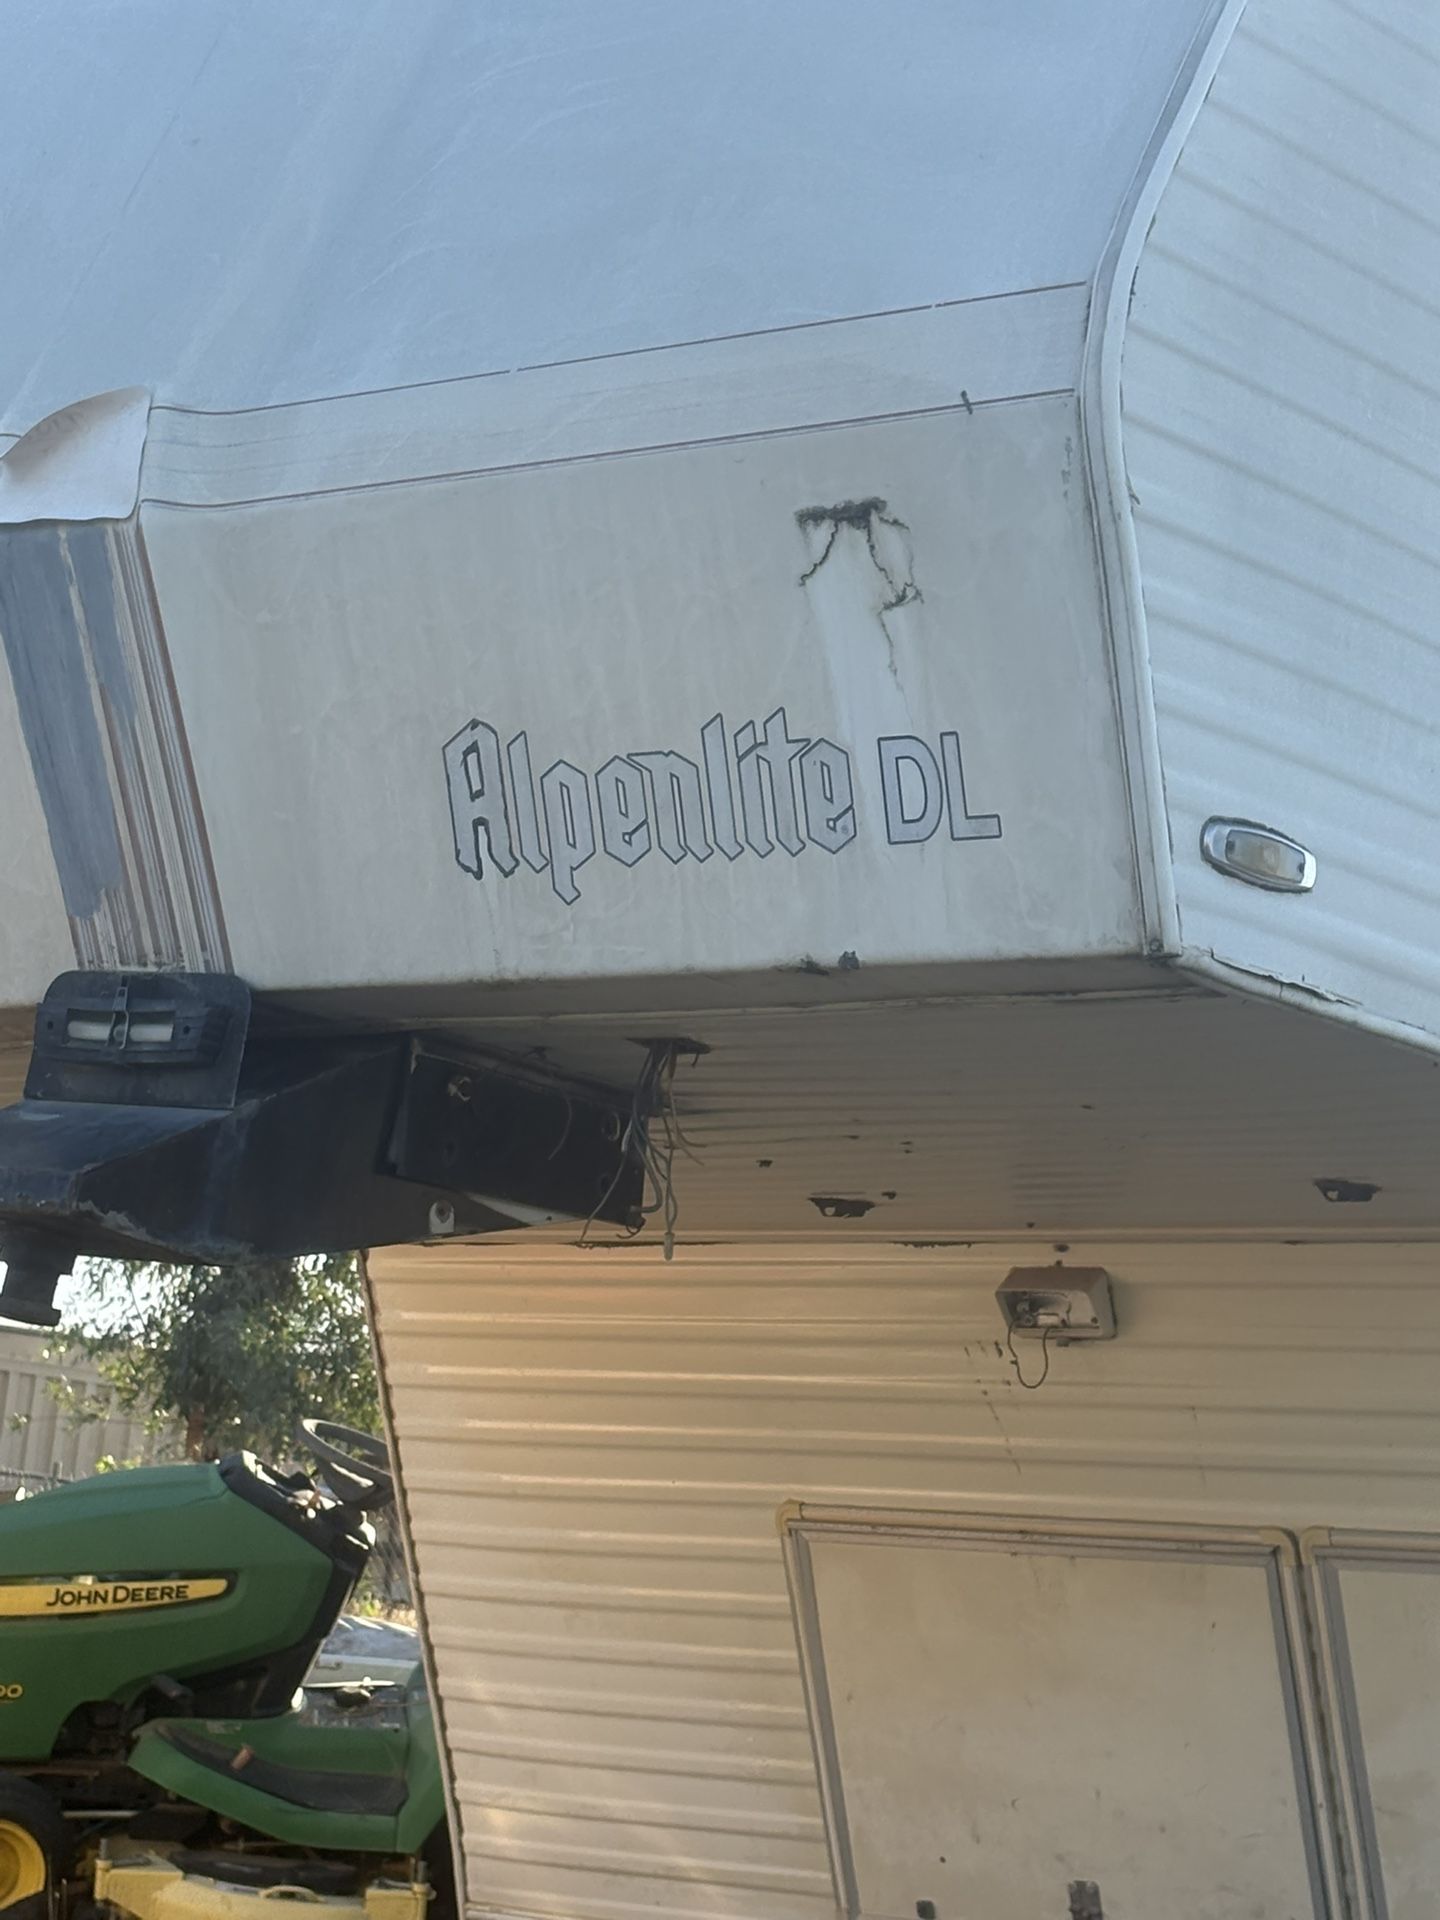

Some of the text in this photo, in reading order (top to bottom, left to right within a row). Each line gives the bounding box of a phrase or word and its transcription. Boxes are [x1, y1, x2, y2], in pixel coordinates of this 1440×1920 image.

[442, 706, 1002, 905] Alpenlite DL
[46, 1585, 190, 1606] JOHN DEERE
